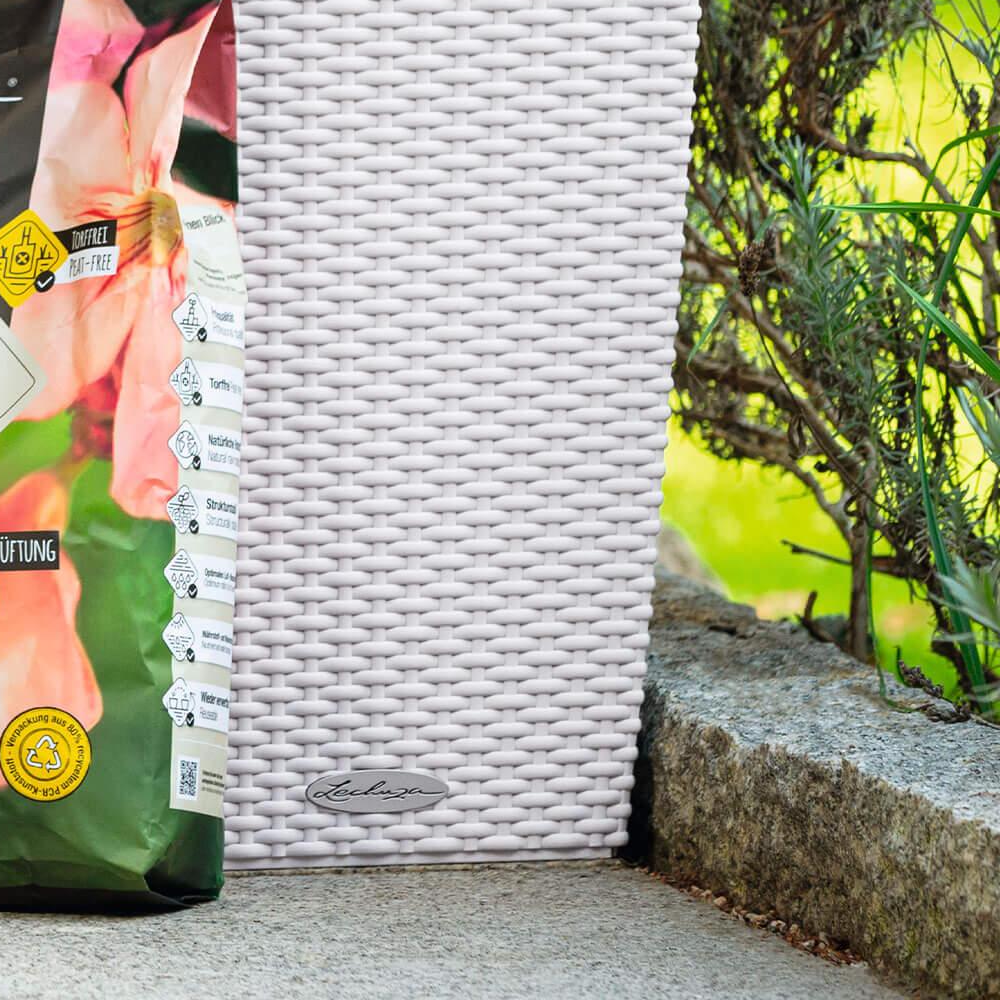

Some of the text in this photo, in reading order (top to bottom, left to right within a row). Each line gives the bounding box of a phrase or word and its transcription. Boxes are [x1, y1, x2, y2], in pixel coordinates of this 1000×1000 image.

[72, 225, 108, 250] TORFFREI
[69, 253, 112, 279] PEAT-FREE
[5, 714, 49, 748] Verpackung
[51, 715, 67, 728] aus
[67, 723, 83, 745] 80%
[62, 744, 85, 790] recyceltem
[313, 779, 445, 803] Lechuza
